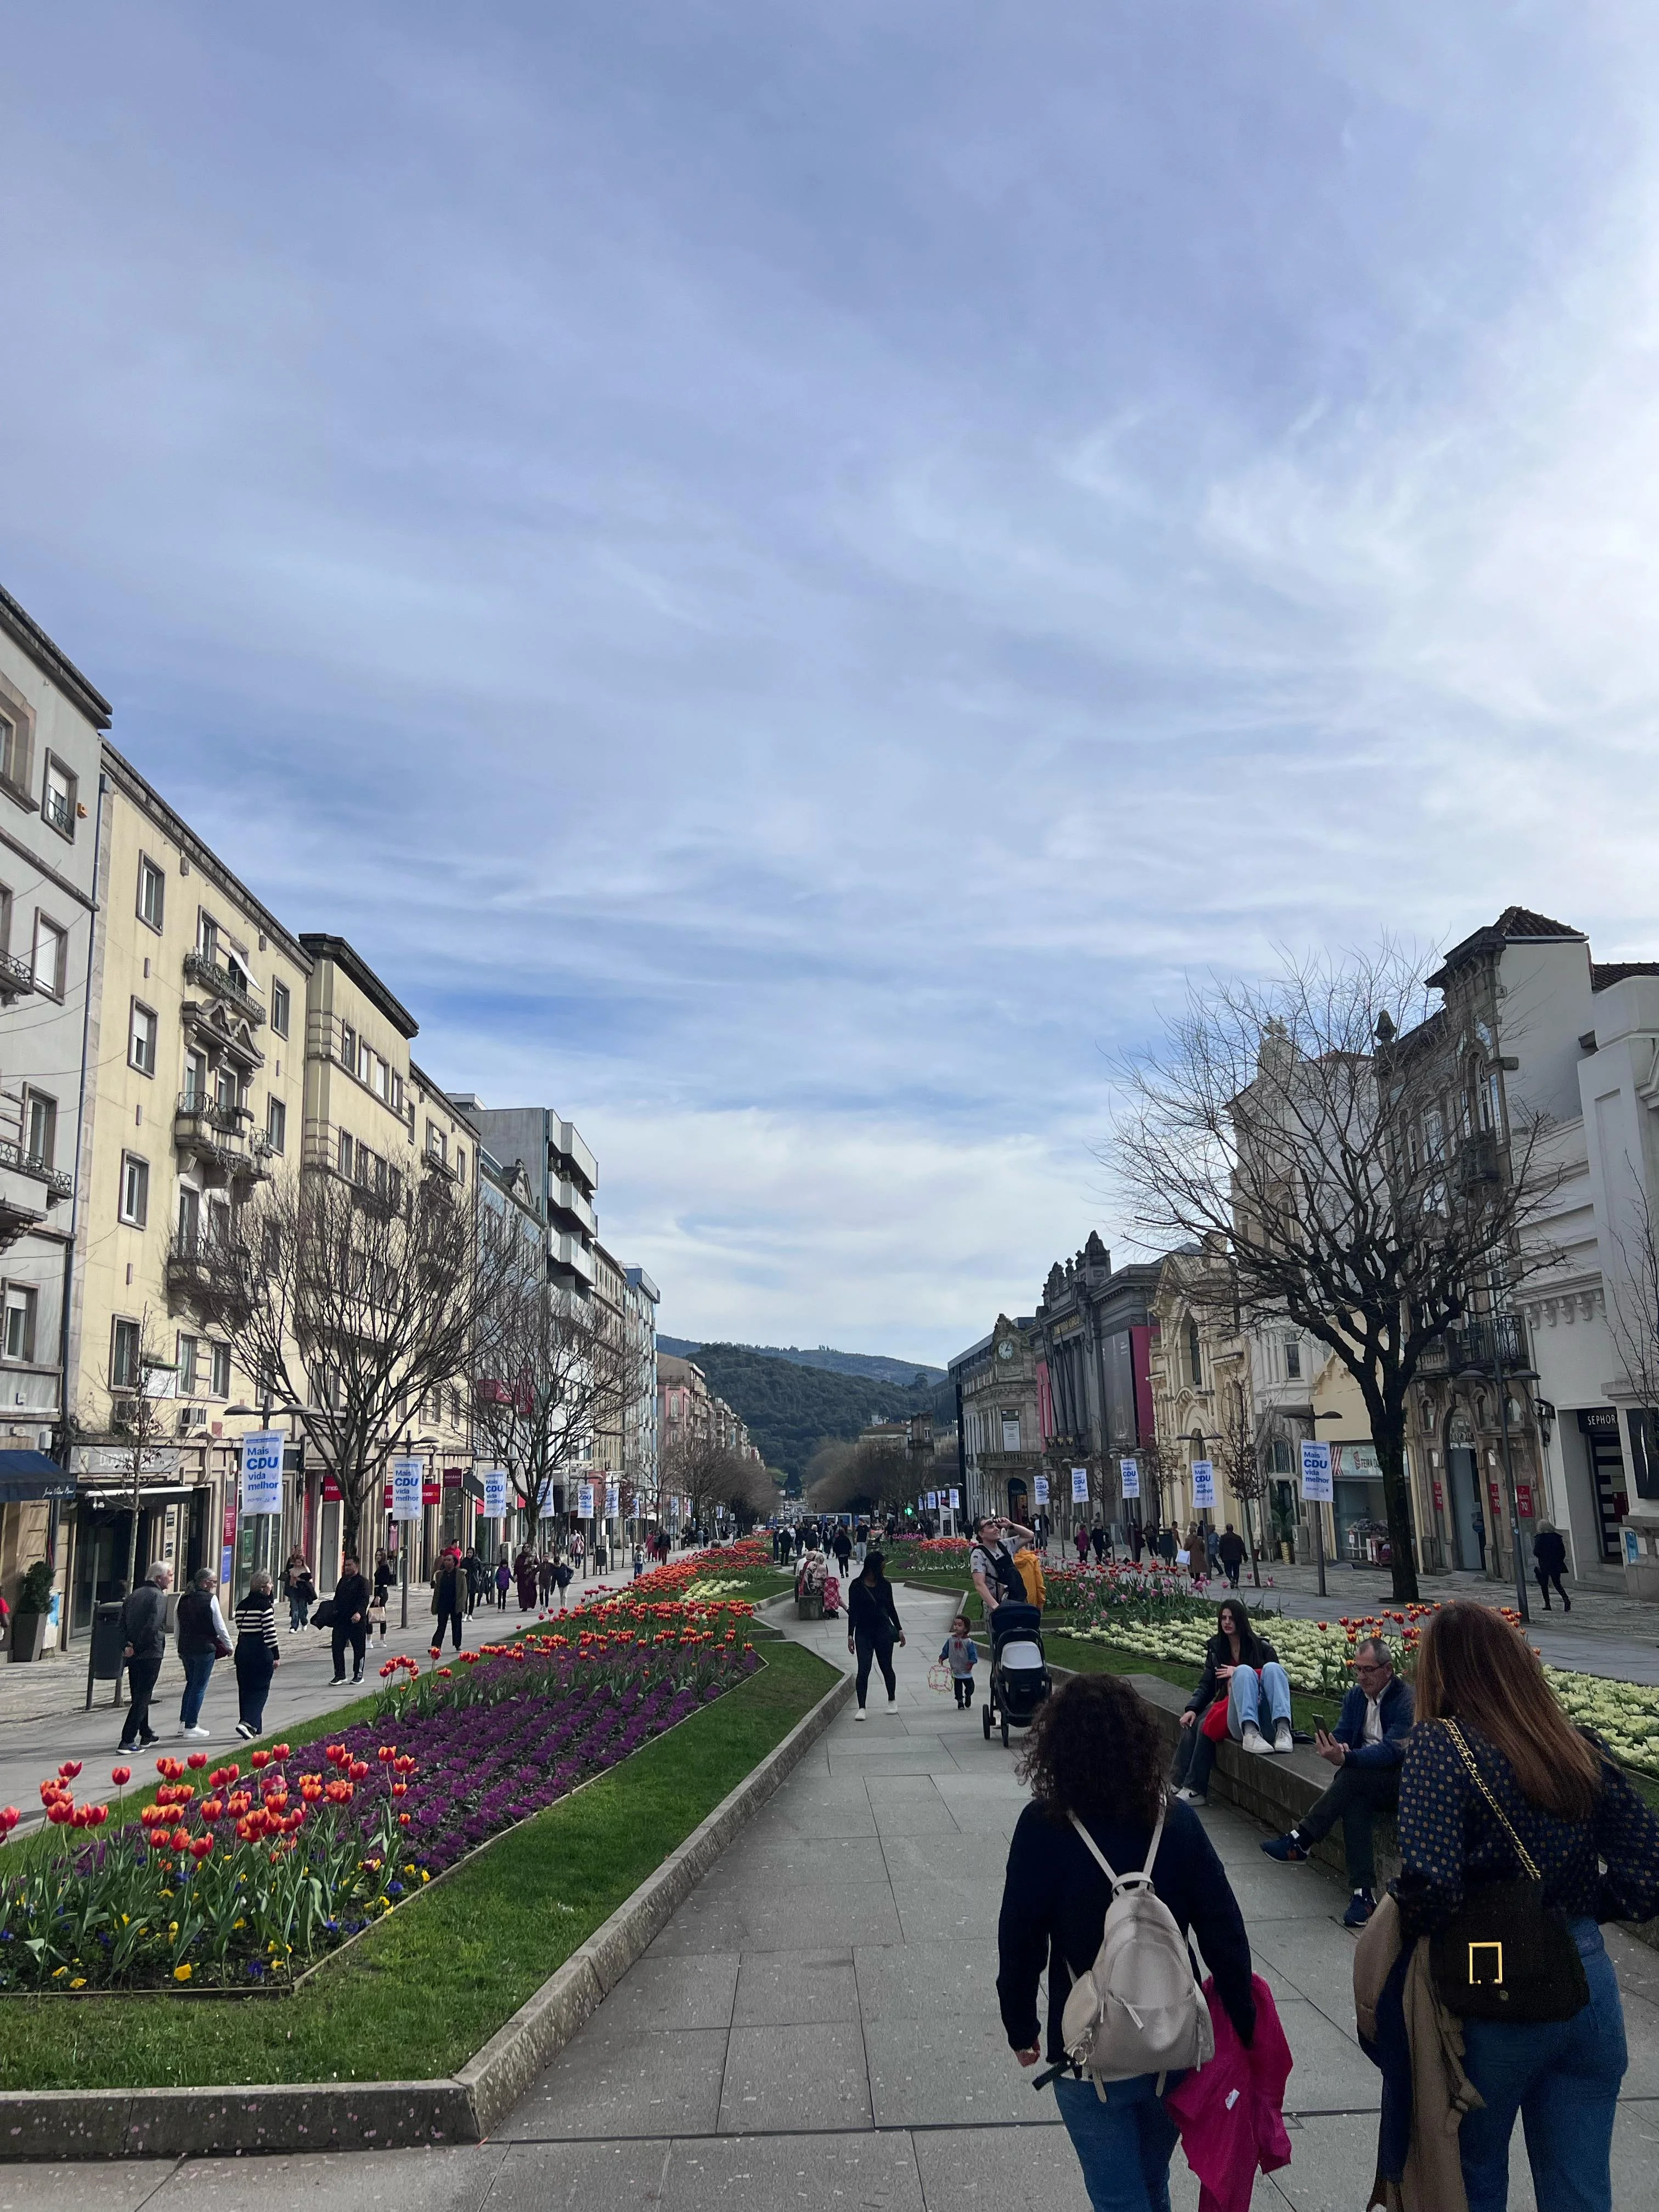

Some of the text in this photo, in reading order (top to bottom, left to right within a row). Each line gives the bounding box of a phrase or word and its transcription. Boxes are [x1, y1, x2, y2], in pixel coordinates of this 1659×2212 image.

[1587, 1414, 1616, 1425] SEPHOR
[247, 1447, 269, 1455] Mais
[247, 1457, 279, 1470] CDU
[1304, 1459, 1327, 1469] CDU
[248, 1471, 266, 1480] vida
[248, 1481, 279, 1491] melhor
[395, 1478, 418, 1486] CDU
